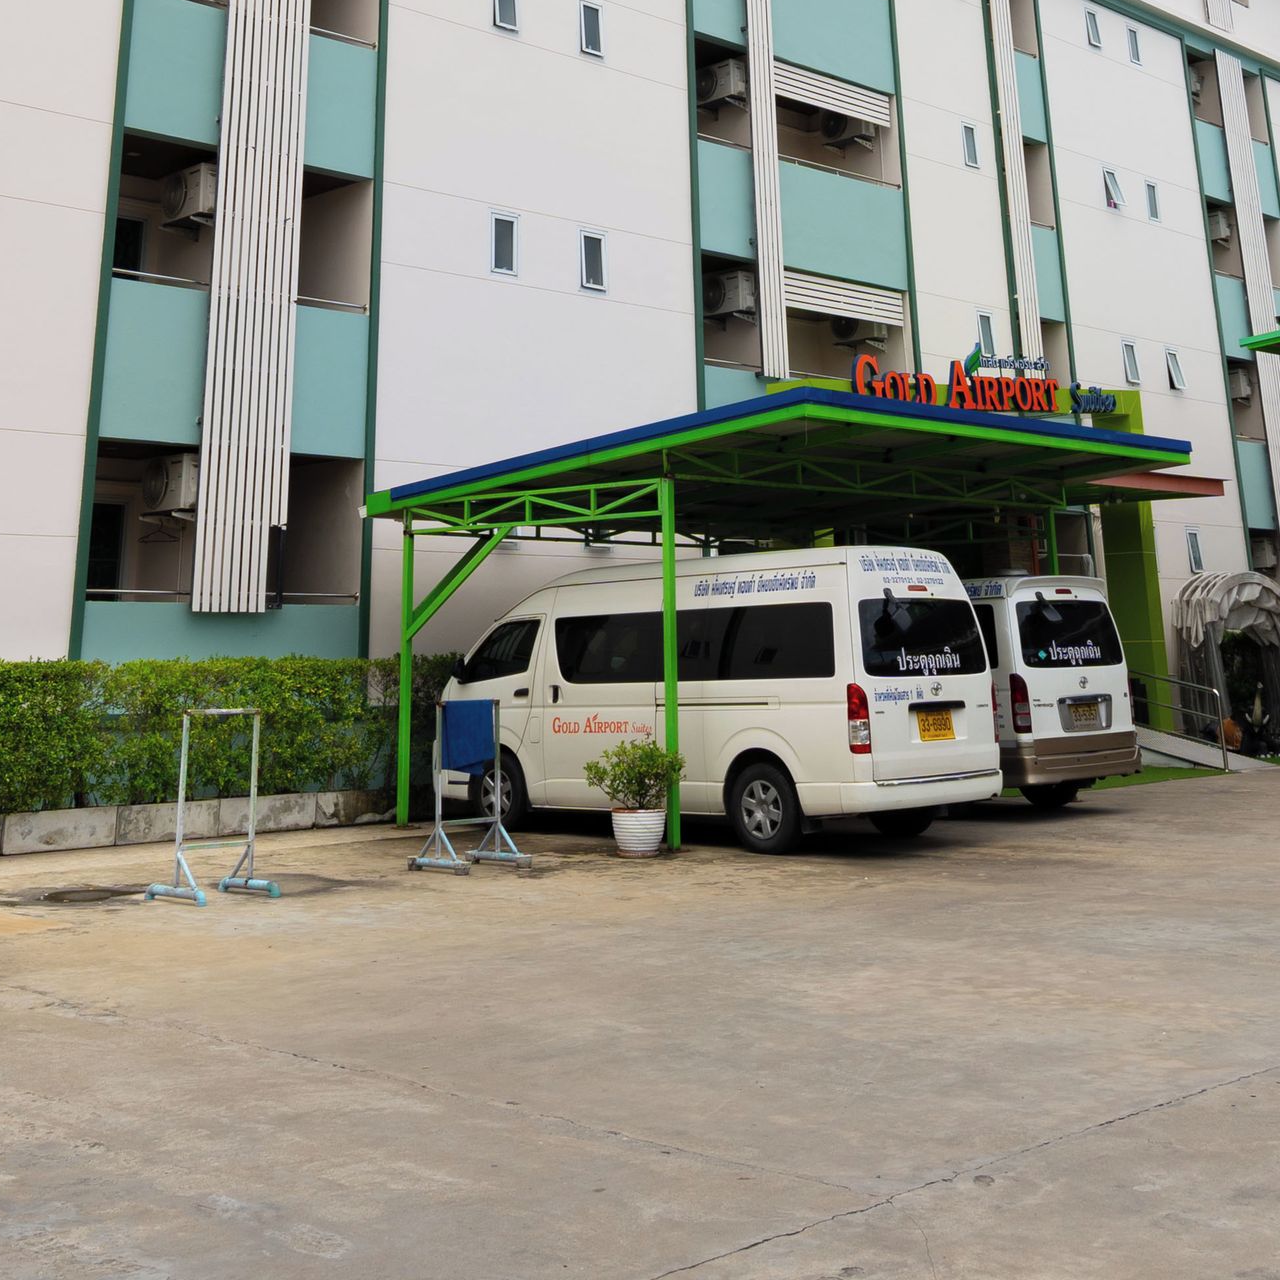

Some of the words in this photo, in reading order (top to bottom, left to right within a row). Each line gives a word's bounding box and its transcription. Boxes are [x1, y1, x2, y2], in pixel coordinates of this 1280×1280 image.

[851, 353, 937, 405] GOLD
[946, 359, 1060, 412] AIRPORT
[1070, 381, 1117, 414] Suites
[897, 646, 961, 676] ประตูฉุกเฉิน
[1048, 639, 1102, 666] ประตูฉุกเฉิน
[552, 716, 580, 734] GOLD
[583, 716, 629, 734] AIRPORT
[631, 721, 653, 734] Suites
[921, 716, 952, 733] 33-6990
